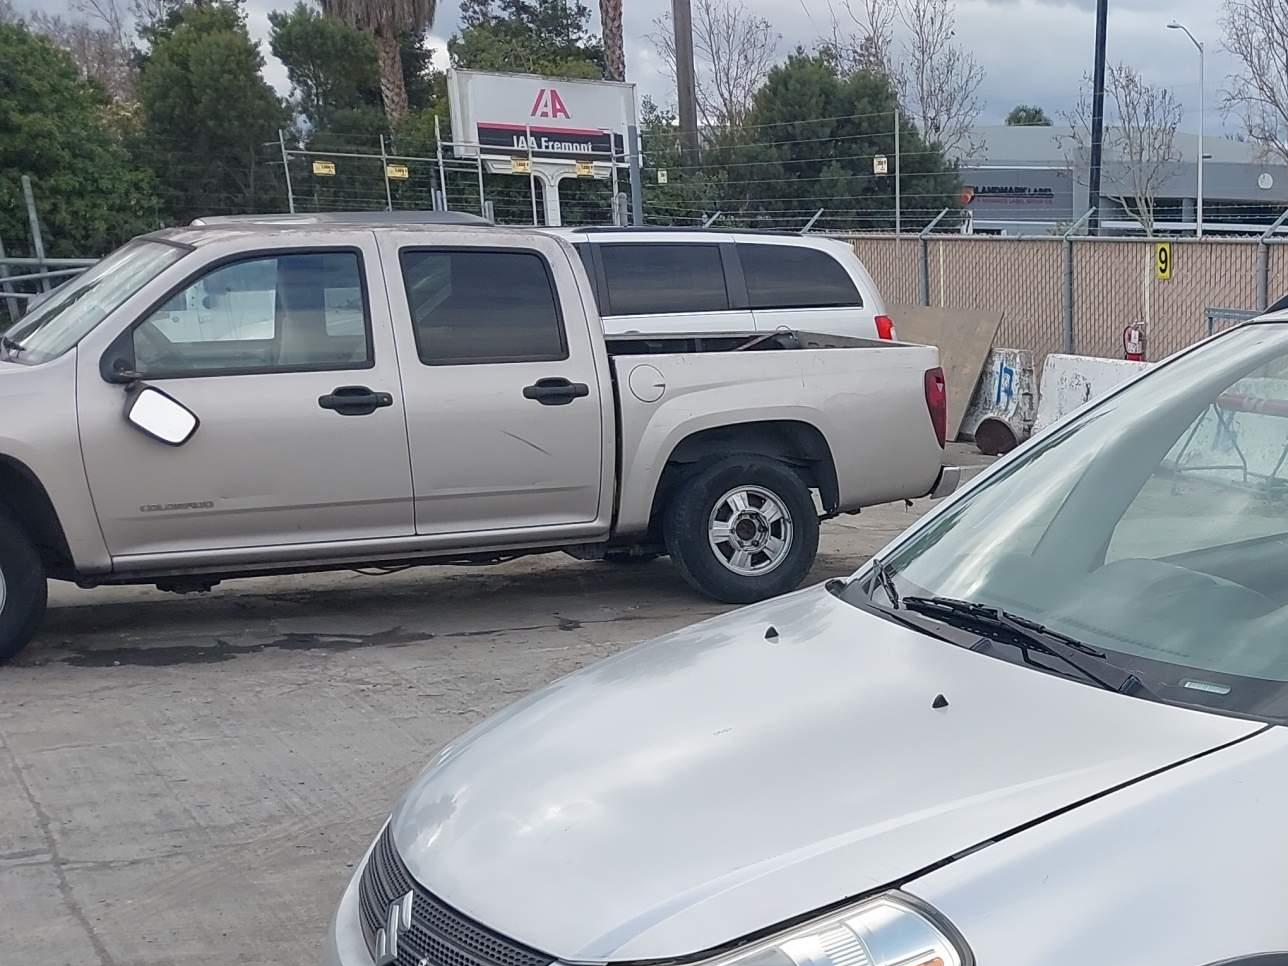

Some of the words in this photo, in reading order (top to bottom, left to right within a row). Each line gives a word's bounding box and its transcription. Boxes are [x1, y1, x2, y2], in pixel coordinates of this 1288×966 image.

[512, 135, 538, 150] IAA
[541, 137, 593, 153] Fremont
[1158, 246, 1168, 274] 9
